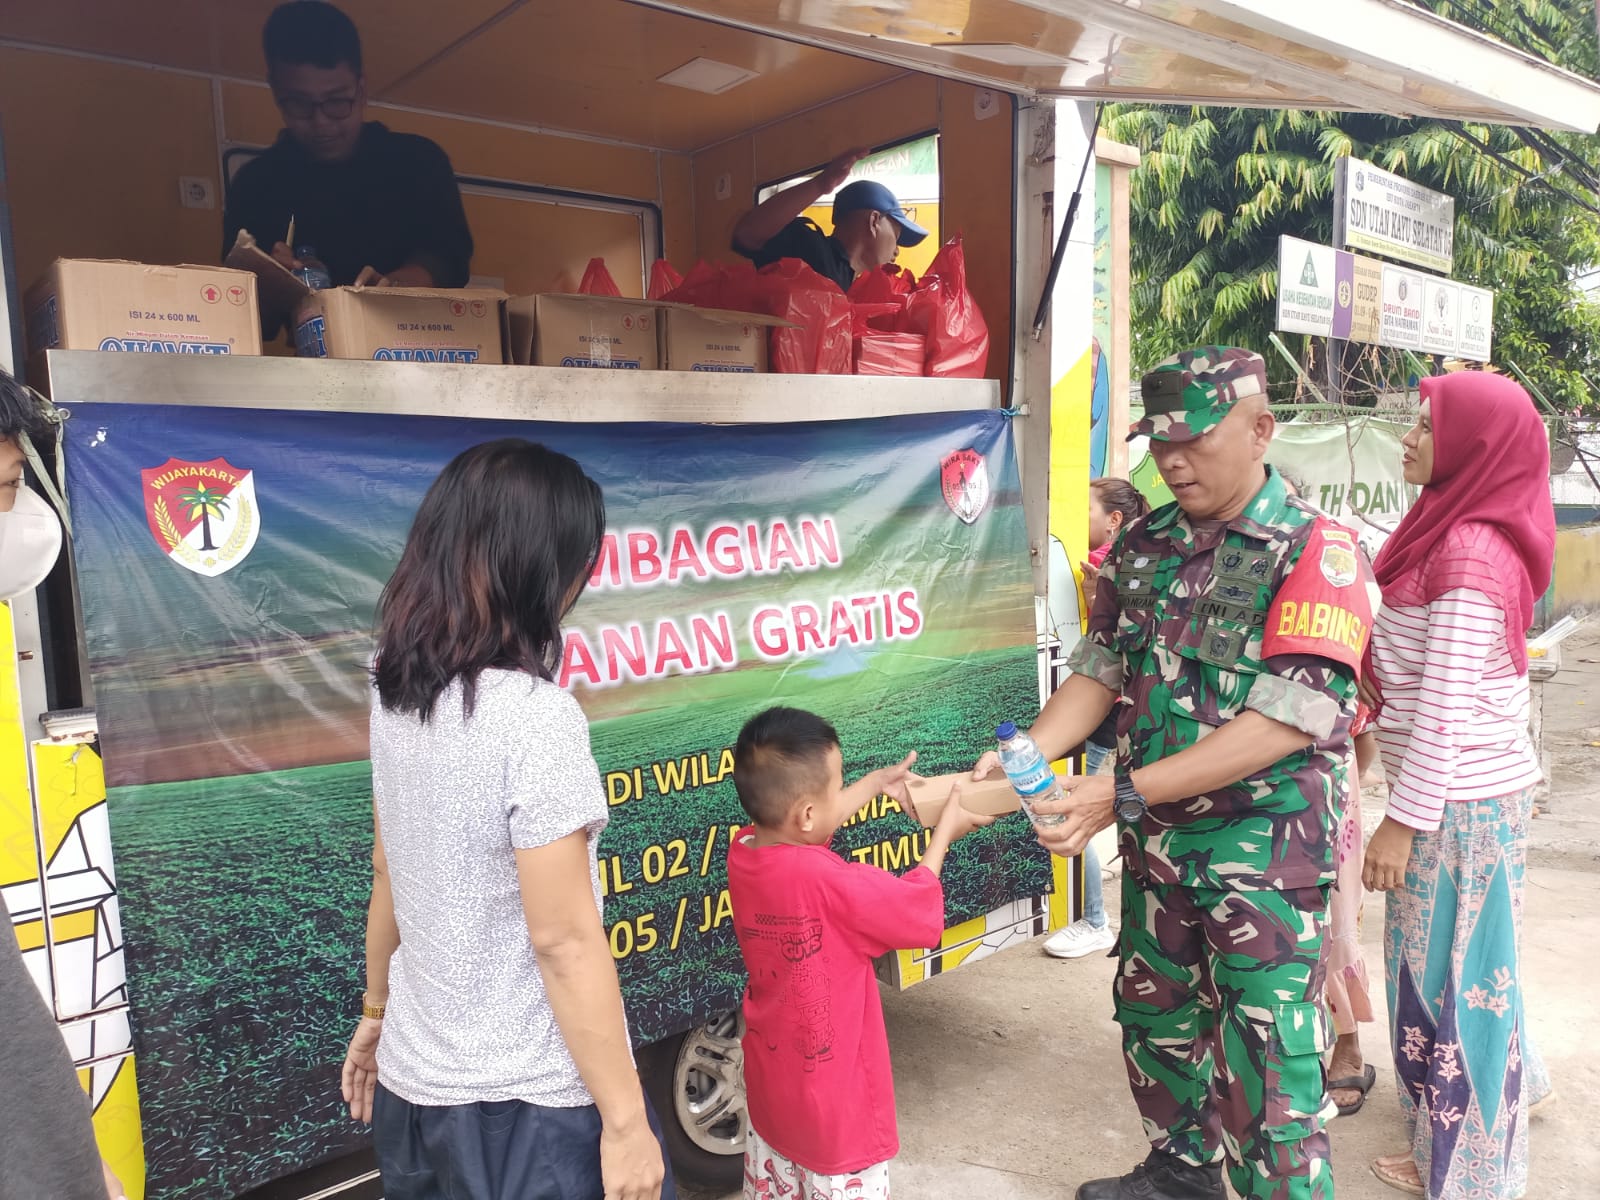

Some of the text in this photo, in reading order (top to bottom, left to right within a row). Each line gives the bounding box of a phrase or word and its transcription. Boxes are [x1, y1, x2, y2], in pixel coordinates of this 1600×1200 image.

[1350, 198, 1367, 230] SDN
[1369, 203, 1389, 236] UTAN
[1391, 211, 1411, 243] KAYU
[1413, 219, 1443, 253] SELATAN
[1357, 282, 1377, 303] GUDEP
[129, 310, 143, 320] ISI
[145, 311, 157, 320] 24
[167, 313, 184, 322] 600
[186, 314, 201, 323] ML
[1383, 303, 1402, 316] DRUM
[1403, 307, 1420, 320] BAND
[410, 323, 420, 331] 24
[428, 323, 442, 332] 600
[443, 324, 456, 332] ML
[943, 454, 960, 470] WIRA
[151, 466, 241, 490] WIJAYAKARTA
[1351, 481, 1401, 515] DAN
[558, 590, 923, 688] ANAN GRATIS
[606, 749, 736, 806] DI WILA
[641, 838, 689, 884] 02
[700, 825, 718, 877] /
[609, 913, 658, 960] 05
[670, 897, 688, 951] /
[698, 889, 735, 933] JA
[781, 935, 822, 962] GUYS
